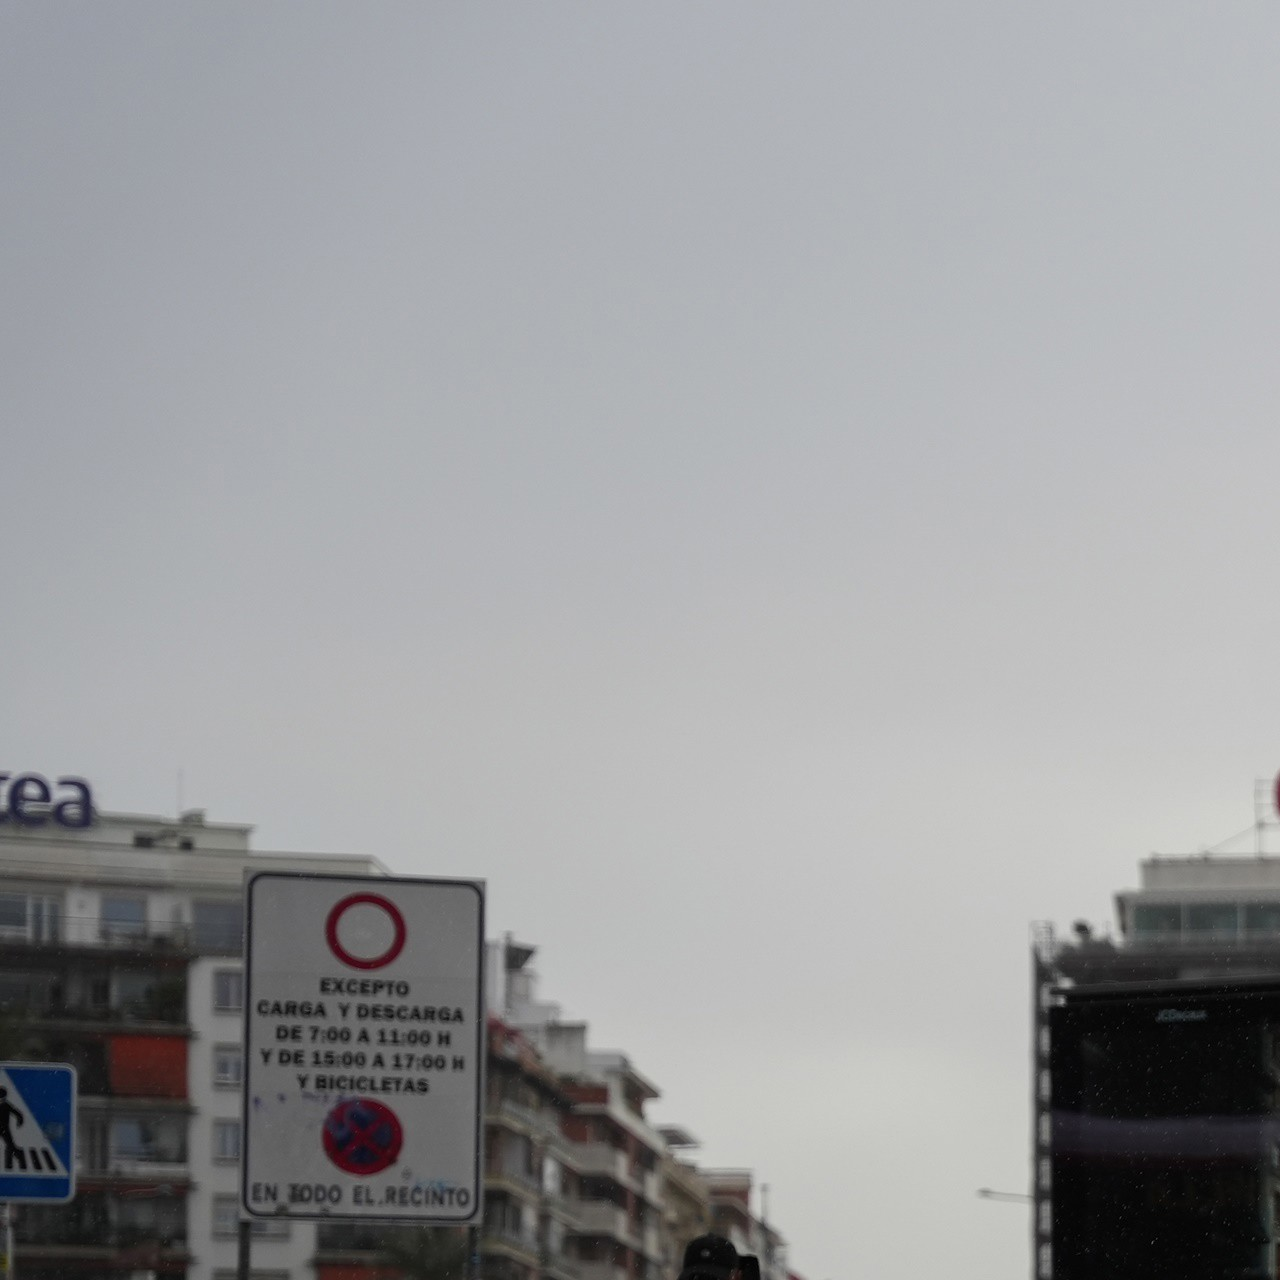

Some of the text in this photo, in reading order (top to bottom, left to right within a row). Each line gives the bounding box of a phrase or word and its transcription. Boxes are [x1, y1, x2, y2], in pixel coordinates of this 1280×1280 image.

[319, 977, 410, 998] EXCEPTO
[257, 999, 464, 1023] CARGA Y DESCARGA
[276, 1024, 452, 1047] DE 7:00 A 11:00 H
[260, 1048, 465, 1072] Y DE 15:00 A 17:00 H
[296, 1073, 430, 1095] Y BICICLETAS
[251, 1182, 278, 1203] EN
[352, 1185, 374, 1206] EL
[385, 1185, 471, 1208] RECINTO
